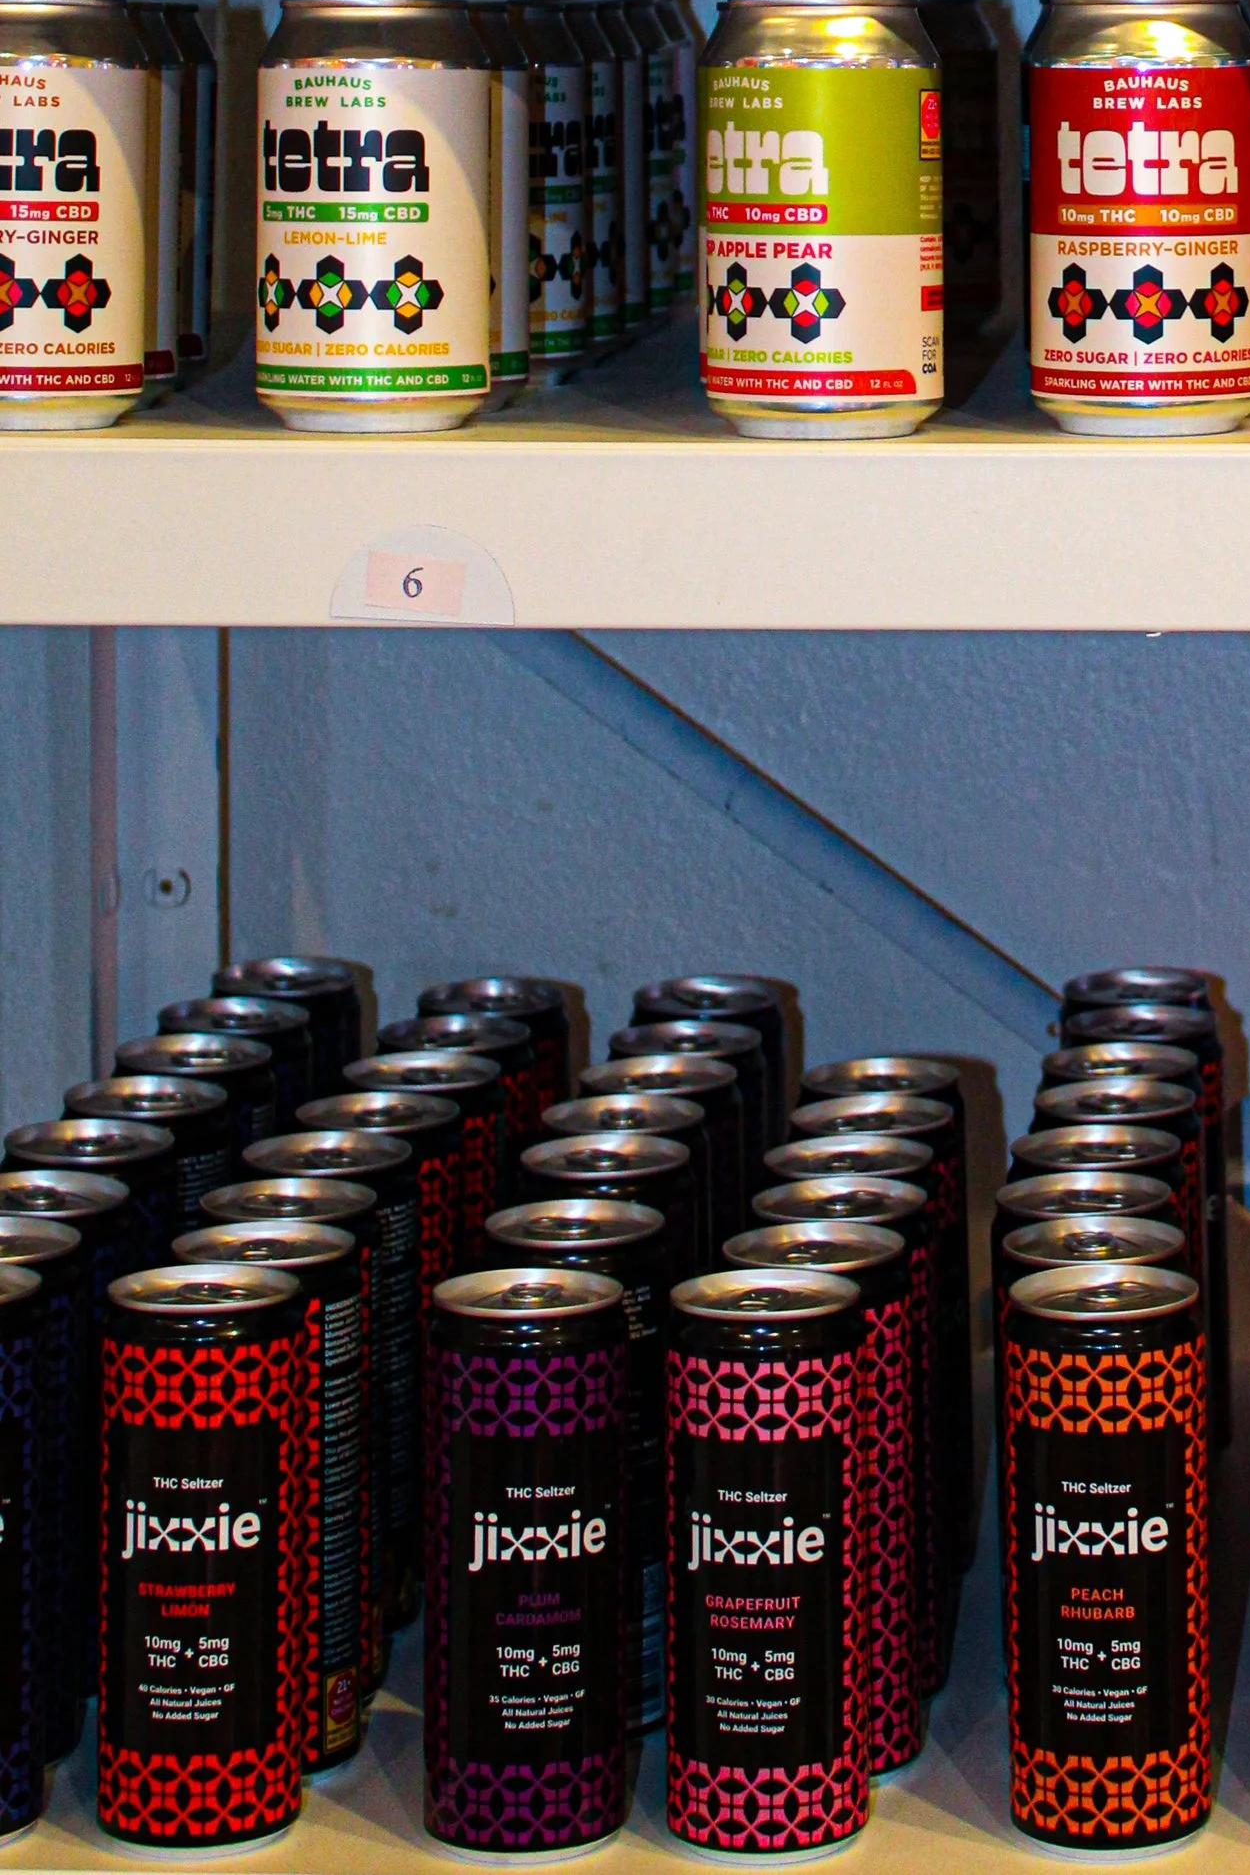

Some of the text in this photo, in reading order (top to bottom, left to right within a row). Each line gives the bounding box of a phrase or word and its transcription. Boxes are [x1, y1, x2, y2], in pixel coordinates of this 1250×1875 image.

[0, 74, 46, 90] HAUS
[294, 76, 372, 91] BAUHAUS
[1104, 76, 1189, 92] BAUHAUS
[13, 95, 60, 107] LABS
[286, 96, 386, 107] BREW LABS
[743, 98, 783, 109] LABS
[1094, 96, 1202, 109] BREW LABS
[263, 120, 430, 193] tetra
[1057, 121, 1238, 195] tetra
[10, 204, 91, 220] 15mg CBD
[745, 206, 822, 222] 10mg CBD
[1061, 209, 1234, 224] 10mg THC 10mg CBD
[284, 231, 387, 245] LEMON-LIME
[718, 242, 832, 260] APPLE PEAR
[403, 567, 423, 598] 6
[153, 1477, 224, 1489] THC Seltzer
[1061, 1481, 1131, 1495] THC Seltzer
[506, 1486, 575, 1499] THC Seltzer
[718, 1490, 787, 1503] THC Seltzer
[122, 1499, 261, 1559] jixxie
[1032, 1502, 1169, 1562] jixxie
[468, 1509, 606, 1571] jixxie
[688, 1511, 825, 1571] jixxie
[1071, 1587, 1124, 1601] PEACH
[1061, 1605, 1135, 1620] RHUBARB
[148, 1654, 228, 1668] THC CBG
[500, 1661, 579, 1678] THC CBG
[715, 1666, 795, 1681] THC CBG
